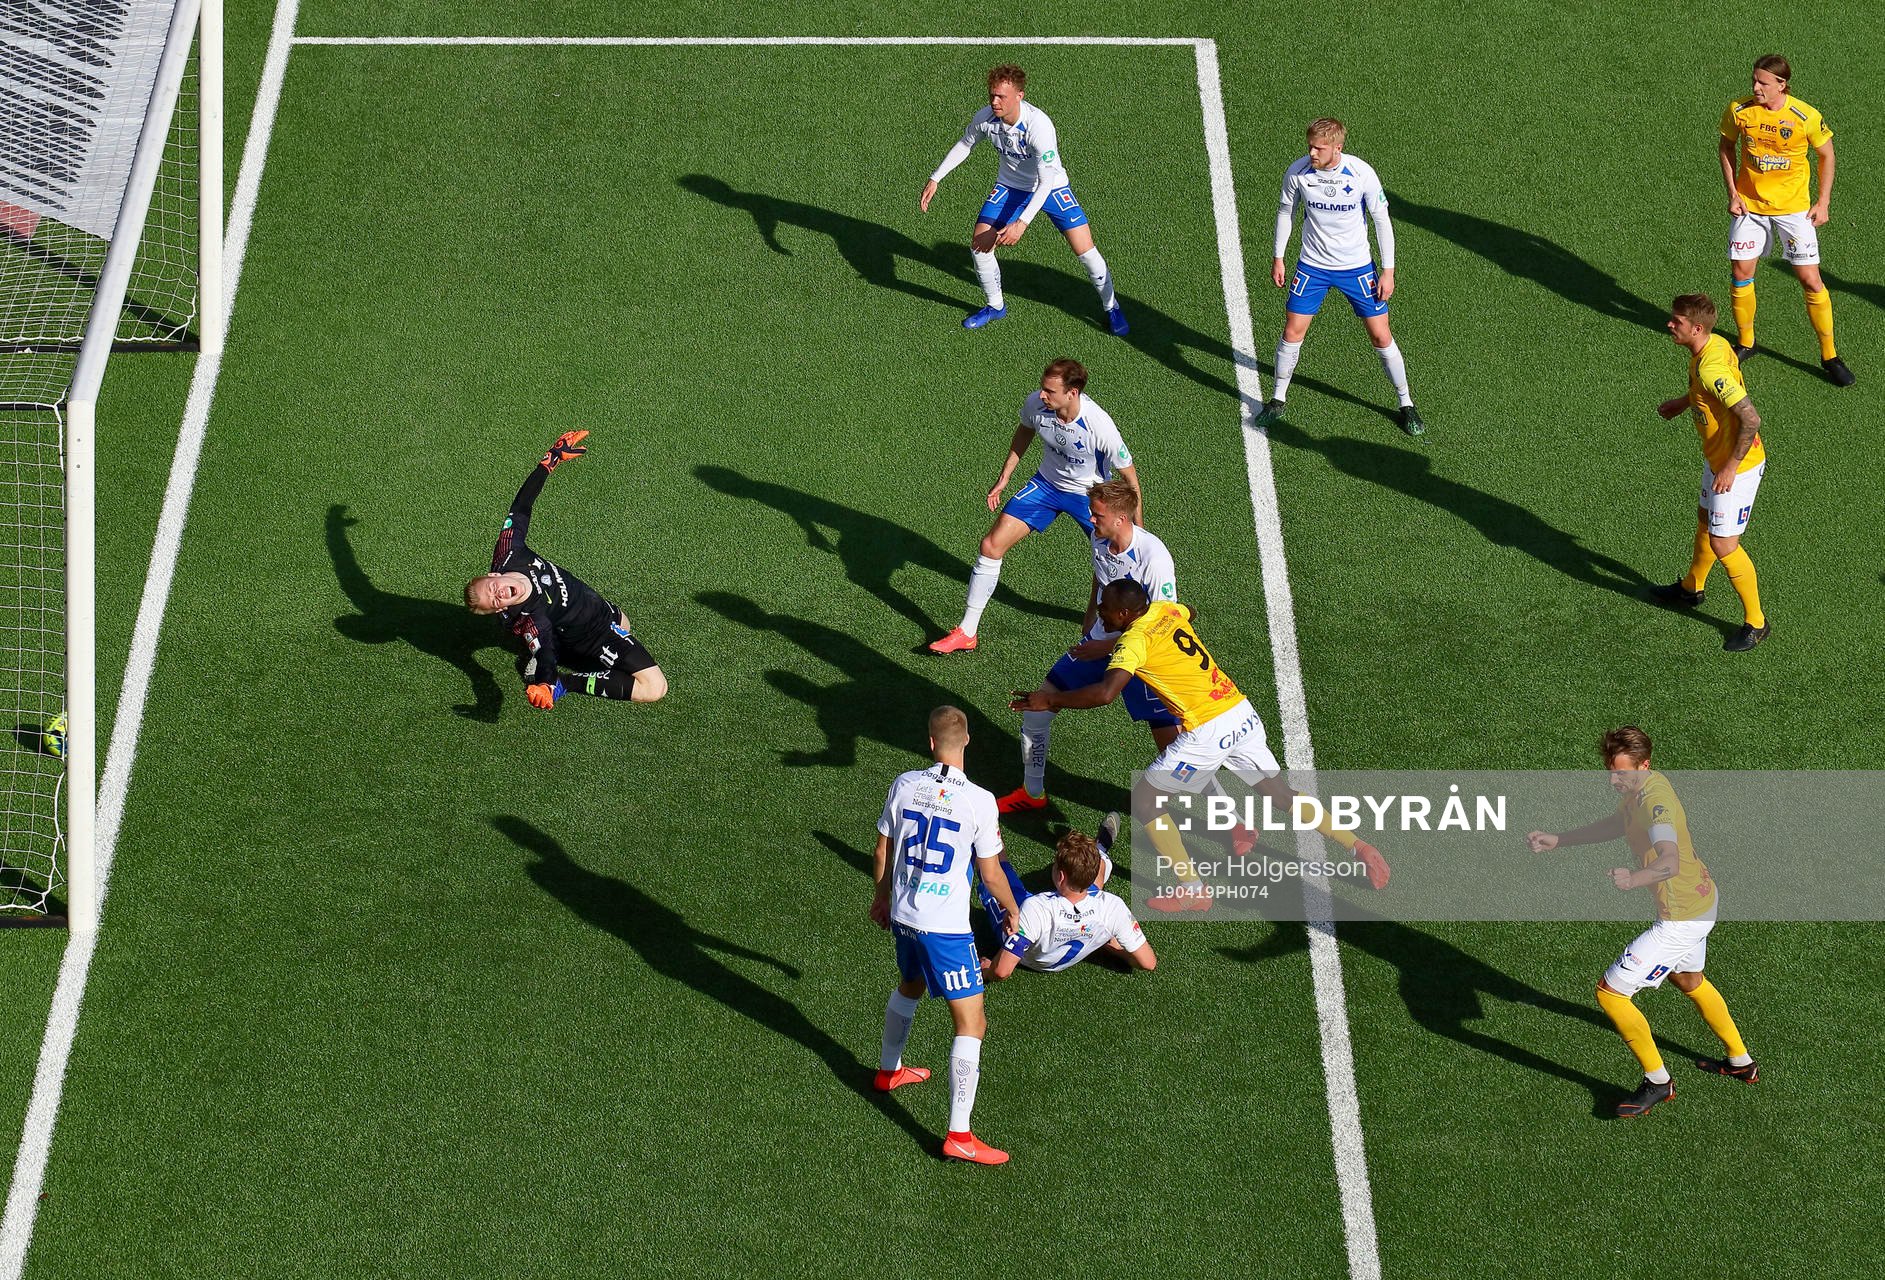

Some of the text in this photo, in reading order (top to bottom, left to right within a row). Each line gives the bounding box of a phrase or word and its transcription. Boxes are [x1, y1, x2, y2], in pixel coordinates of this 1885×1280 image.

[1760, 123, 1777, 133] FBG
[1307, 200, 1356, 212] HOLMEN
[1173, 628, 1210, 671] 9
[903, 809, 960, 875] 25
[943, 965, 972, 991] nt
[957, 1077, 968, 1103] suez
